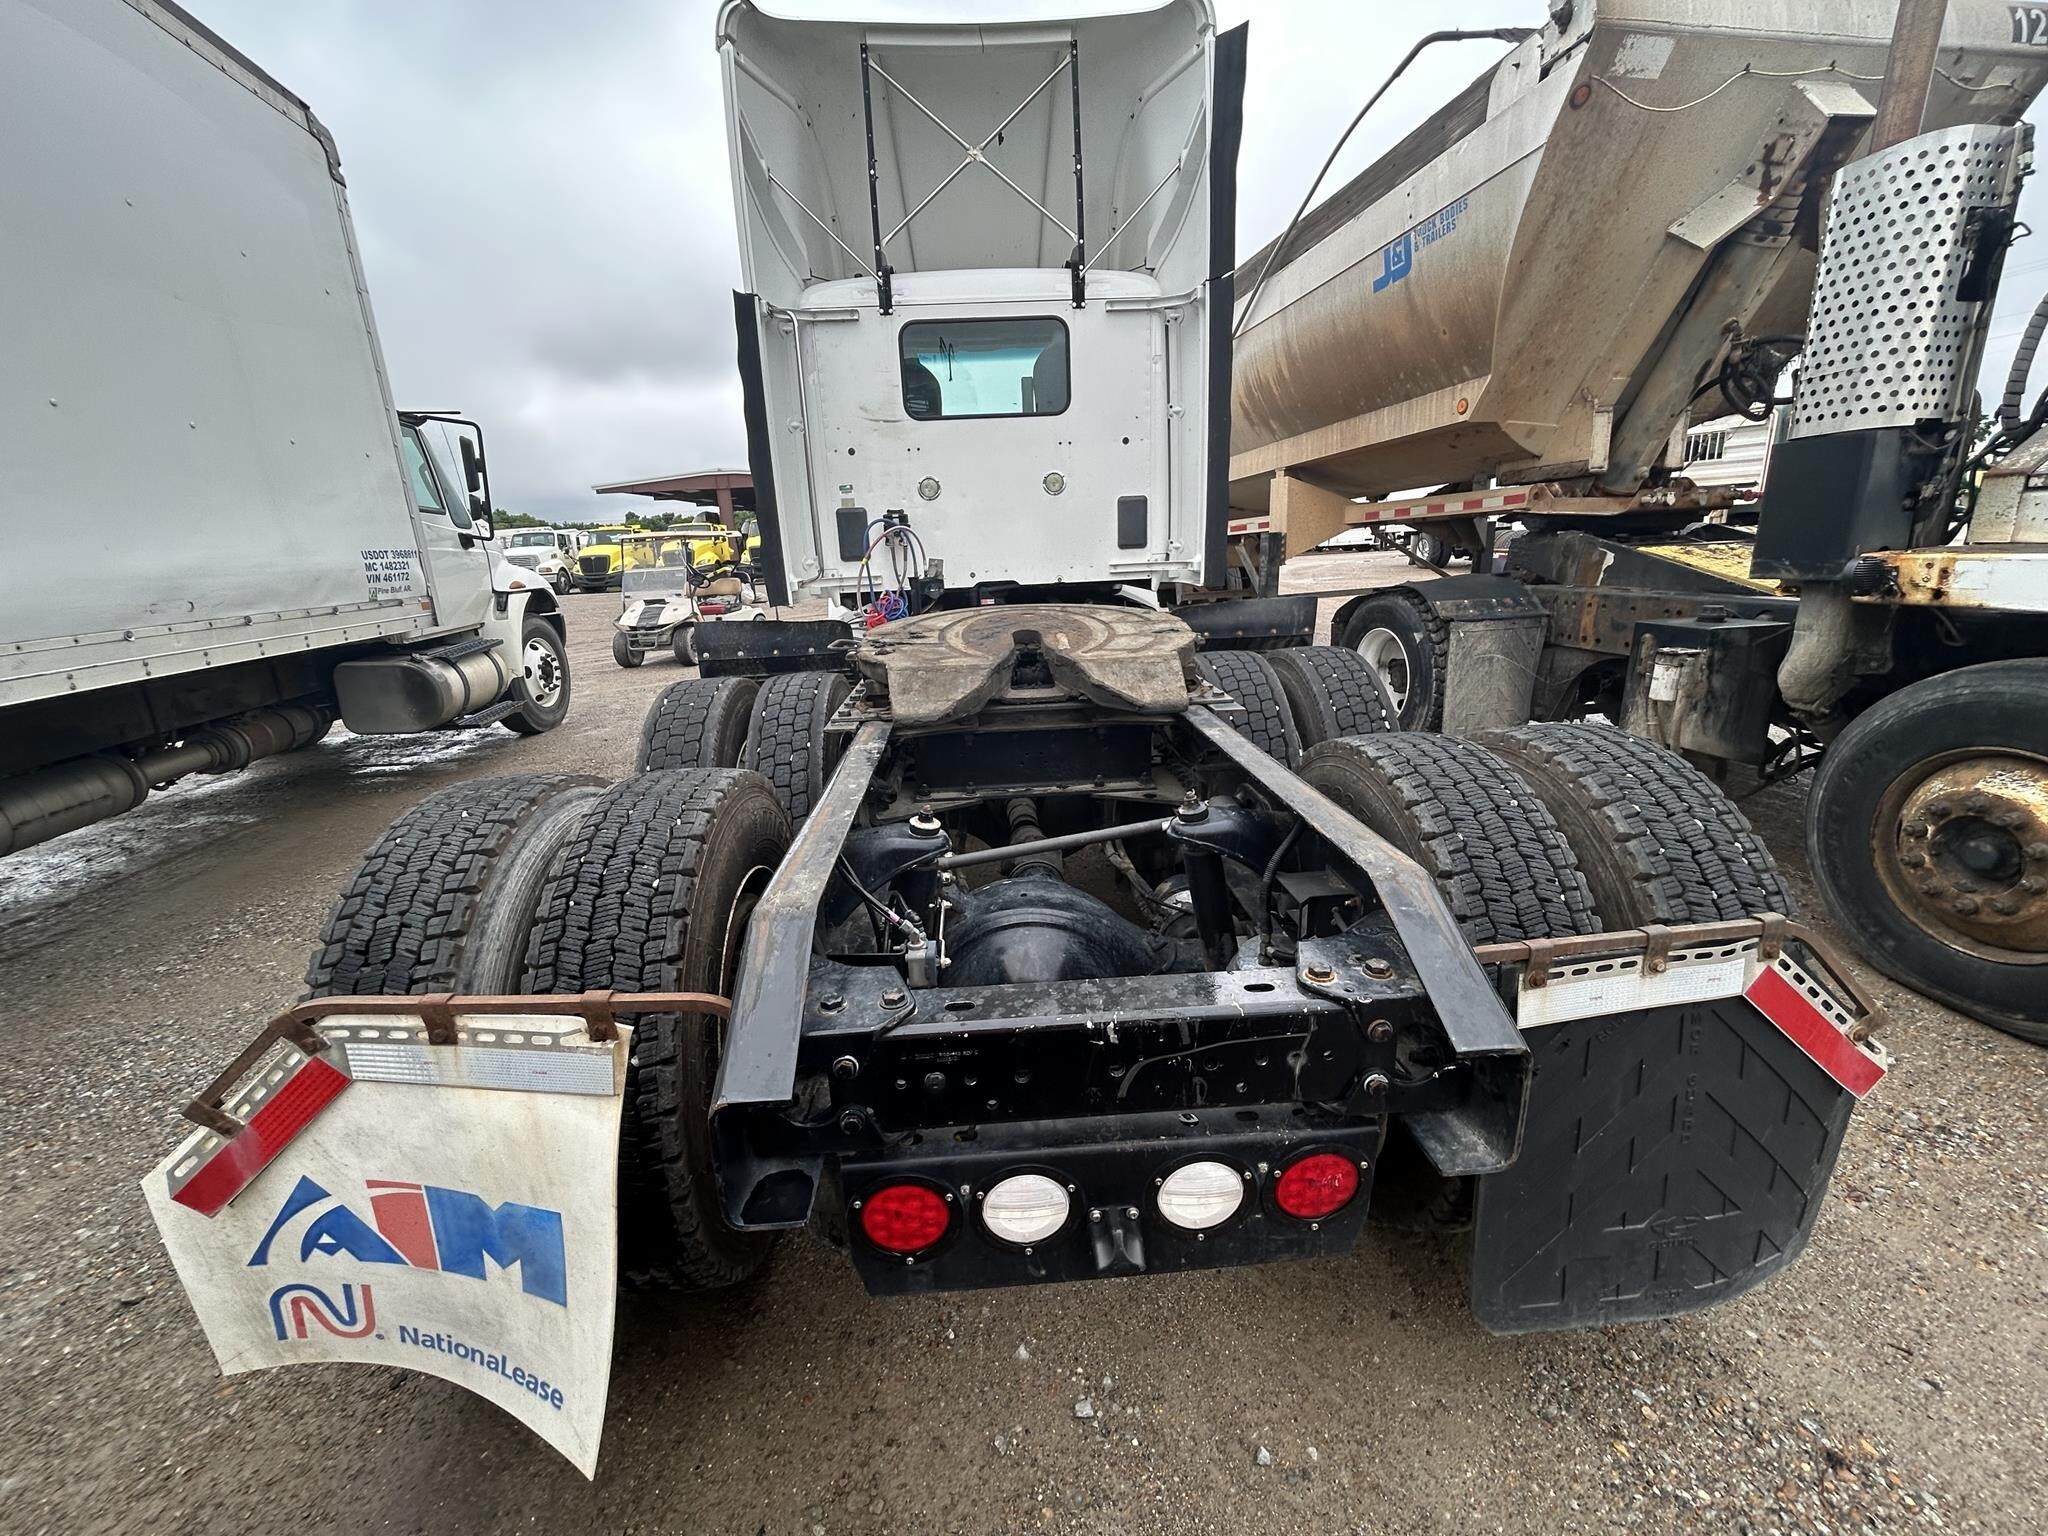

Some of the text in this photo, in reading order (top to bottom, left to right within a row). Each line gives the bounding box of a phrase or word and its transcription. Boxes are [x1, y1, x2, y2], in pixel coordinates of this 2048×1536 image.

[2015, 7, 2047, 45] 12
[1439, 197, 1468, 225] BODIES
[1421, 219, 1457, 247] TRAILERS
[361, 550, 389, 560] USDOT
[364, 561, 410, 572] MC 1482321
[366, 572, 410, 583] VIN 461172
[246, 1174, 568, 1308] AIM
[399, 1324, 565, 1412] NationaLease
